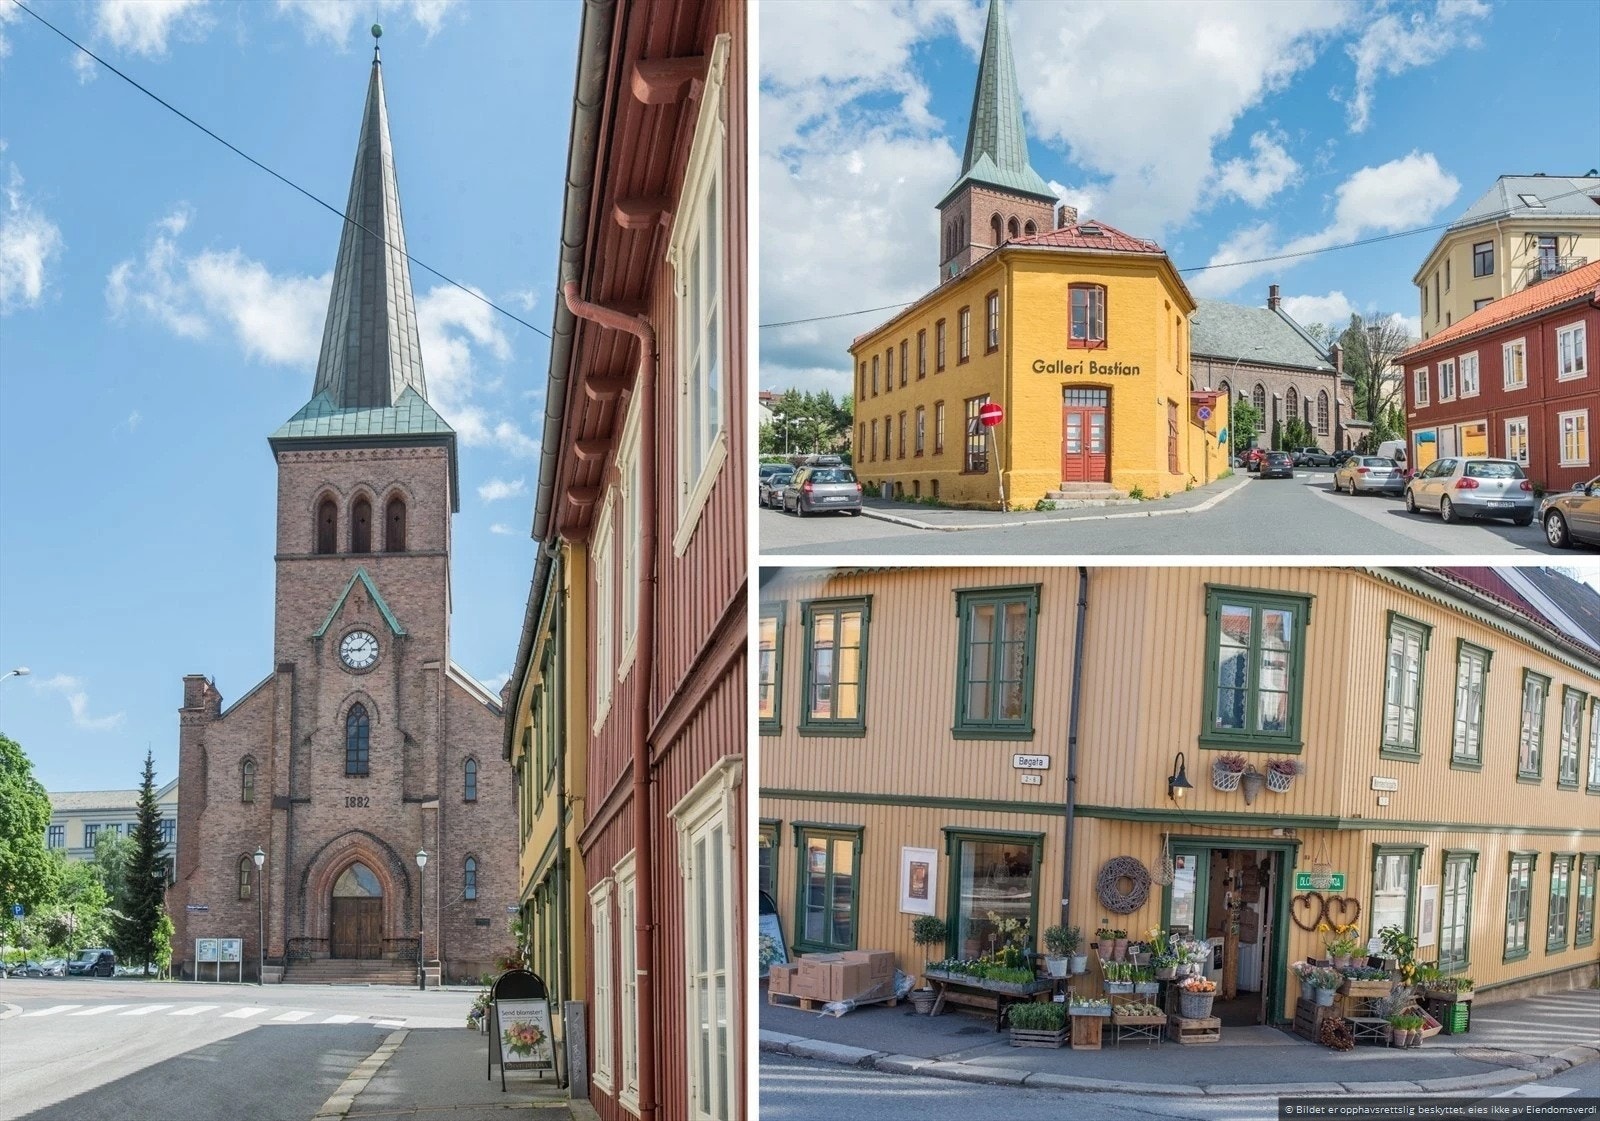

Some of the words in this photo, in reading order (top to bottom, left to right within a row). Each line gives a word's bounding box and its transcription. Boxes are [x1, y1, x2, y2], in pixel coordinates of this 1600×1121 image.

[1032, 359, 1083, 374] Galleri
[1089, 360, 1140, 376] Bastian
[1018, 757, 1043, 767] Bøgata
[345, 796, 370, 808] 1882
